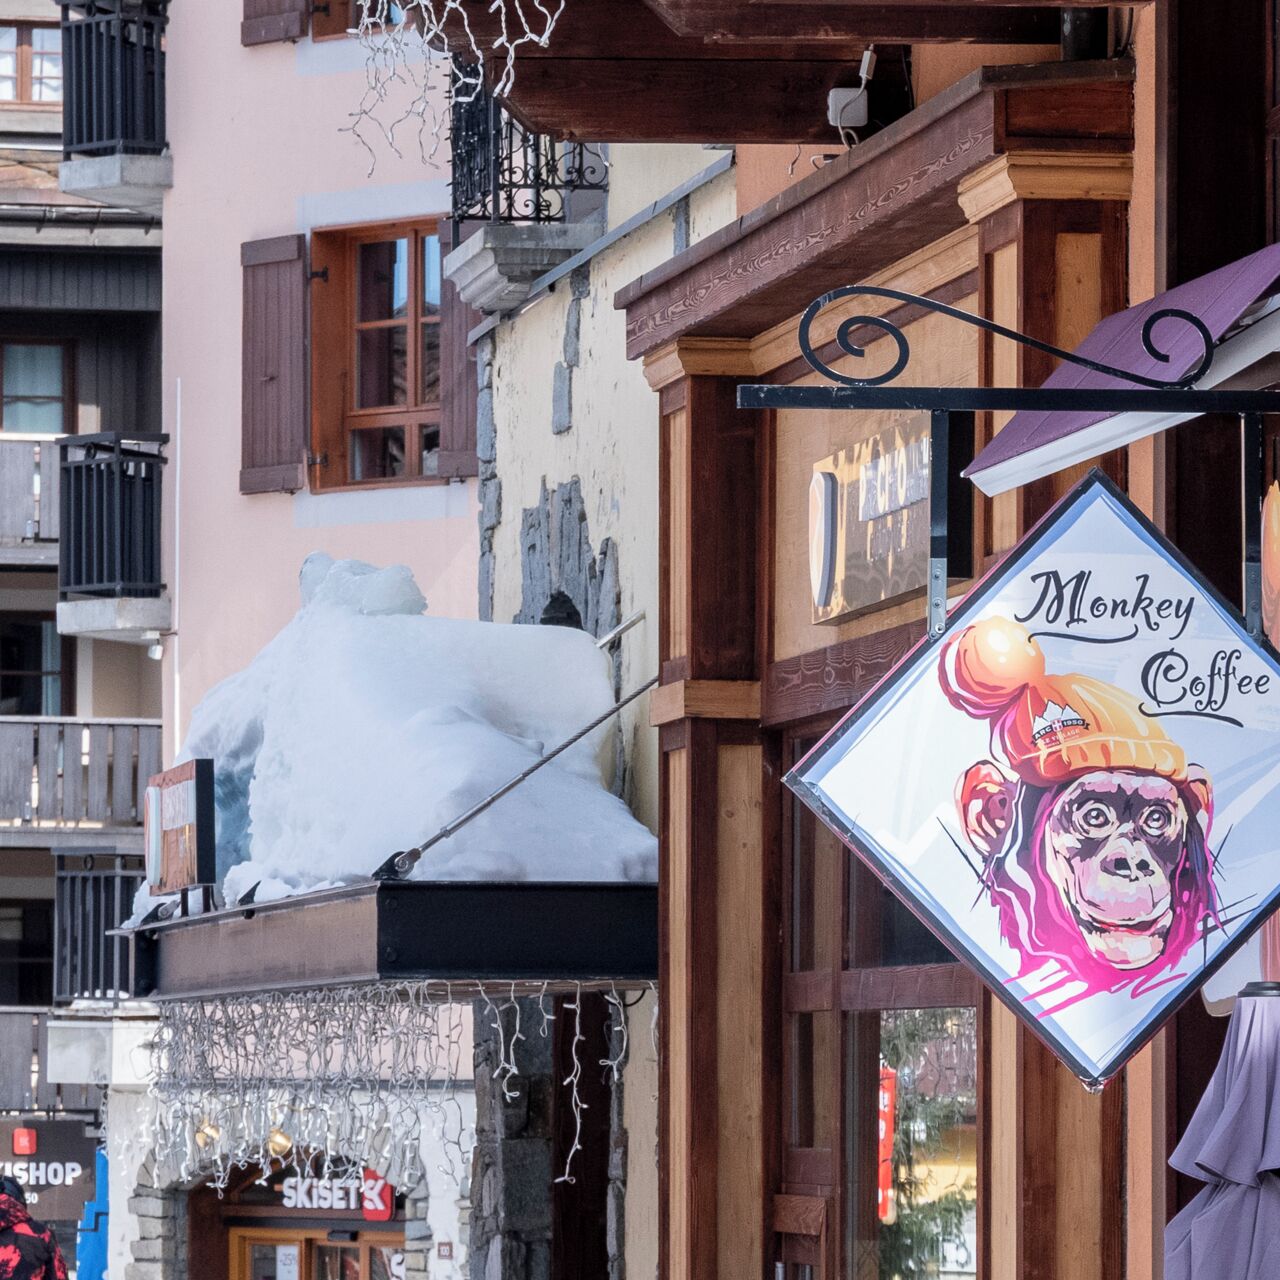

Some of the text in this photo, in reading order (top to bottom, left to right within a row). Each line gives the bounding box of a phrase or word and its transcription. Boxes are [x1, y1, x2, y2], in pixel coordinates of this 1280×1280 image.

[1014, 569, 1195, 641] Monkey
[1140, 648, 1270, 711] Coffee
[1034, 719, 1084, 740] ARC 1950
[1053, 728, 1080, 741] VILAGE
